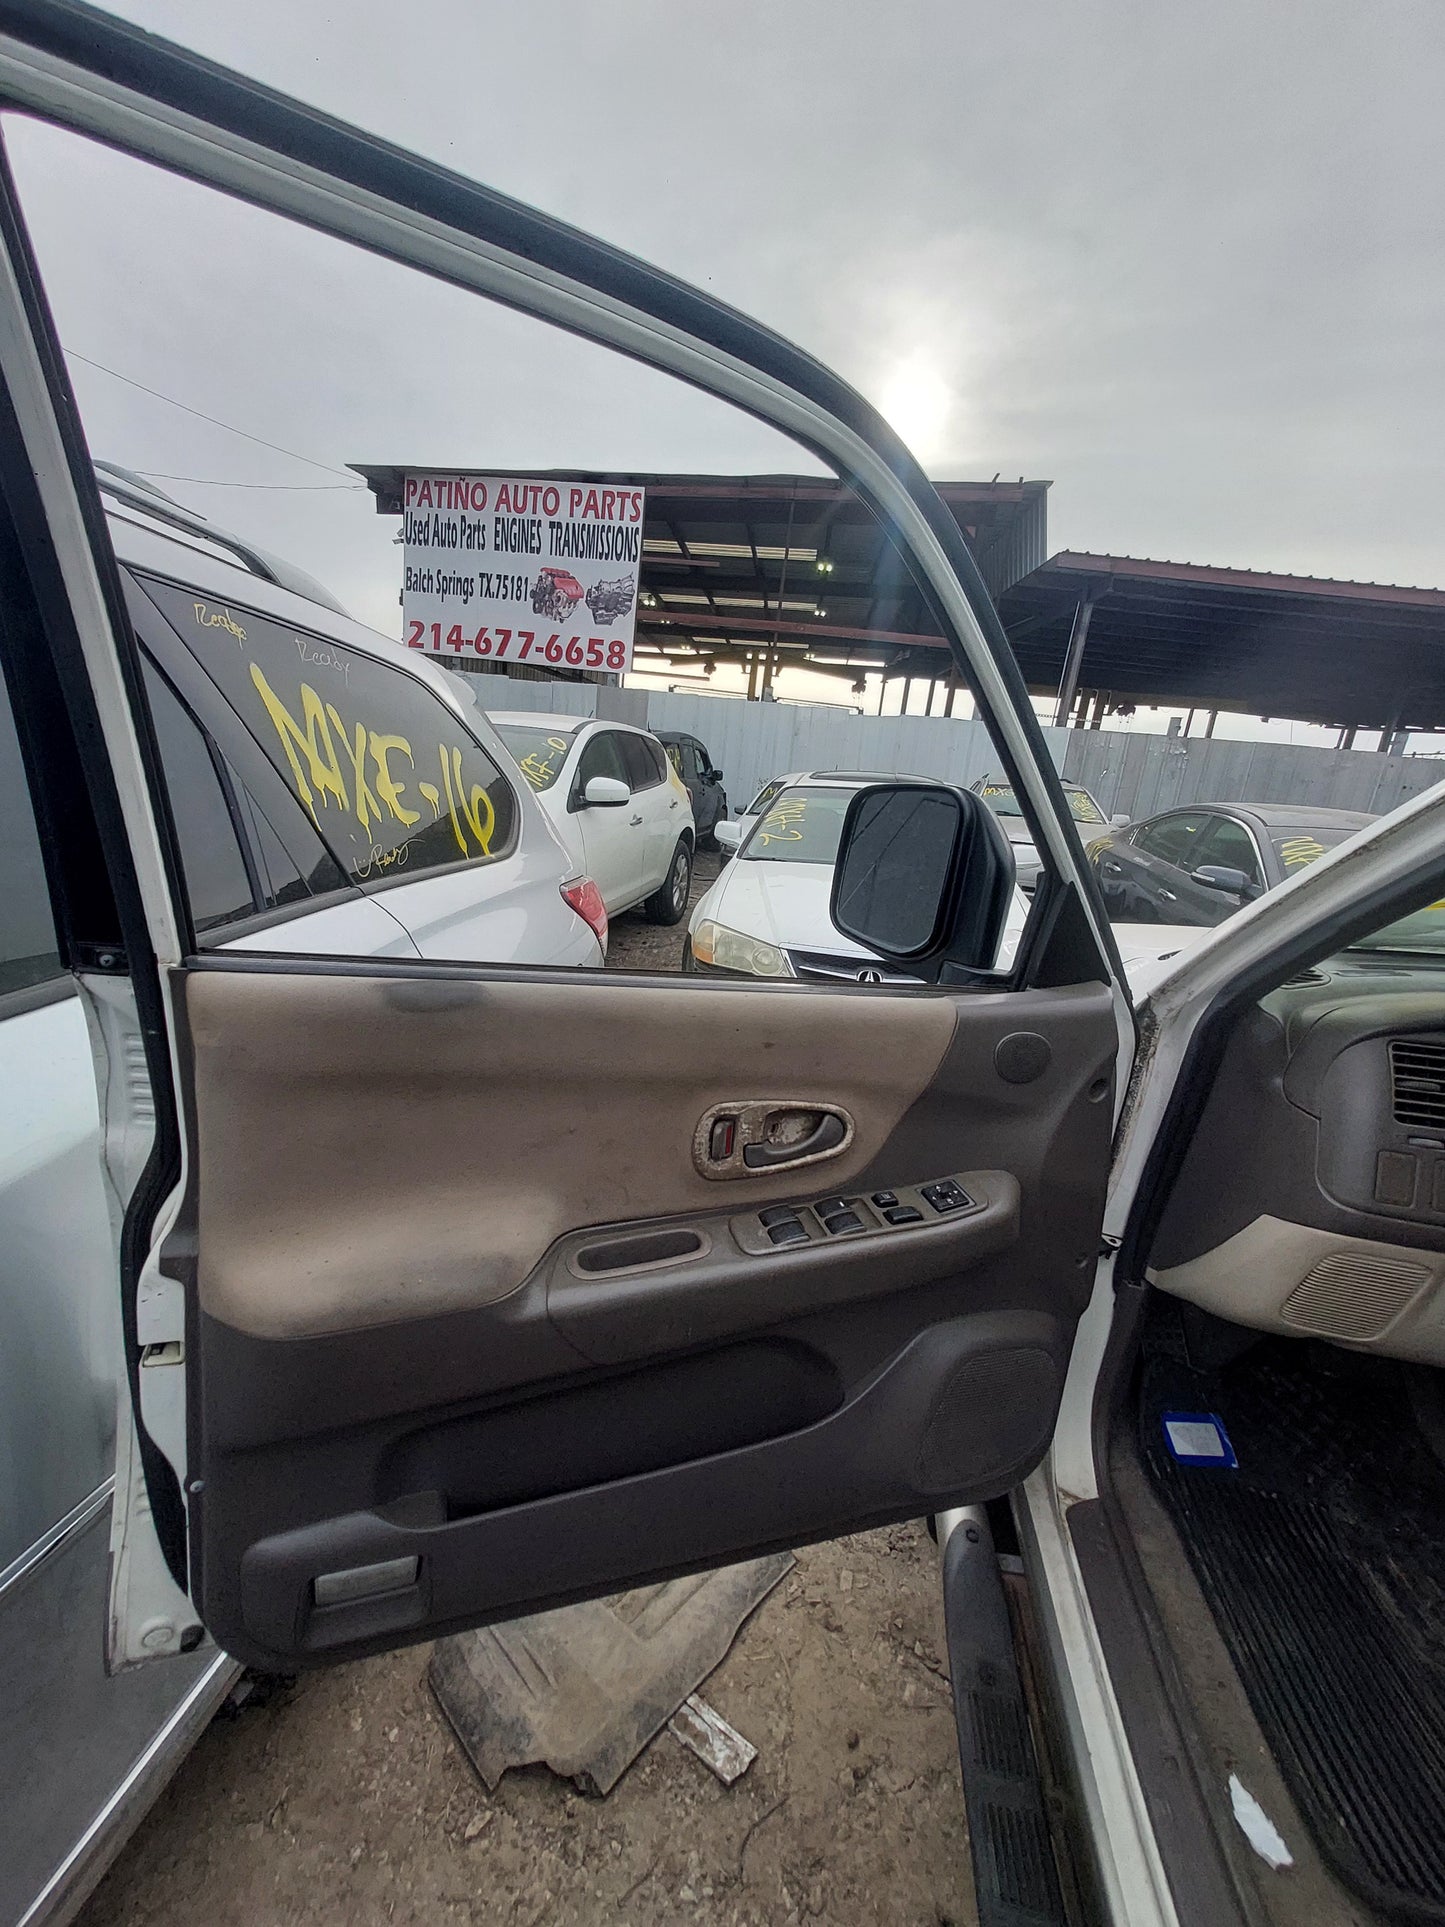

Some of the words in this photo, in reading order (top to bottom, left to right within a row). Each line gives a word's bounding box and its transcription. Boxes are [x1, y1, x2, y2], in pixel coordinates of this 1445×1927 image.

[405, 477, 488, 512] PATIÑO
[494, 484, 561, 517] AUTO
[569, 488, 642, 522] PARTS
[405, 511, 429, 546] Used
[432, 513, 457, 549] Auto
[459, 515, 486, 550] Parts
[494, 517, 542, 555] ENGINES
[549, 521, 640, 562] TRANSMISSIONS
[405, 566, 433, 593] Balch
[436, 569, 474, 604] Springs
[408, 620, 625, 669] 214-677-6658
